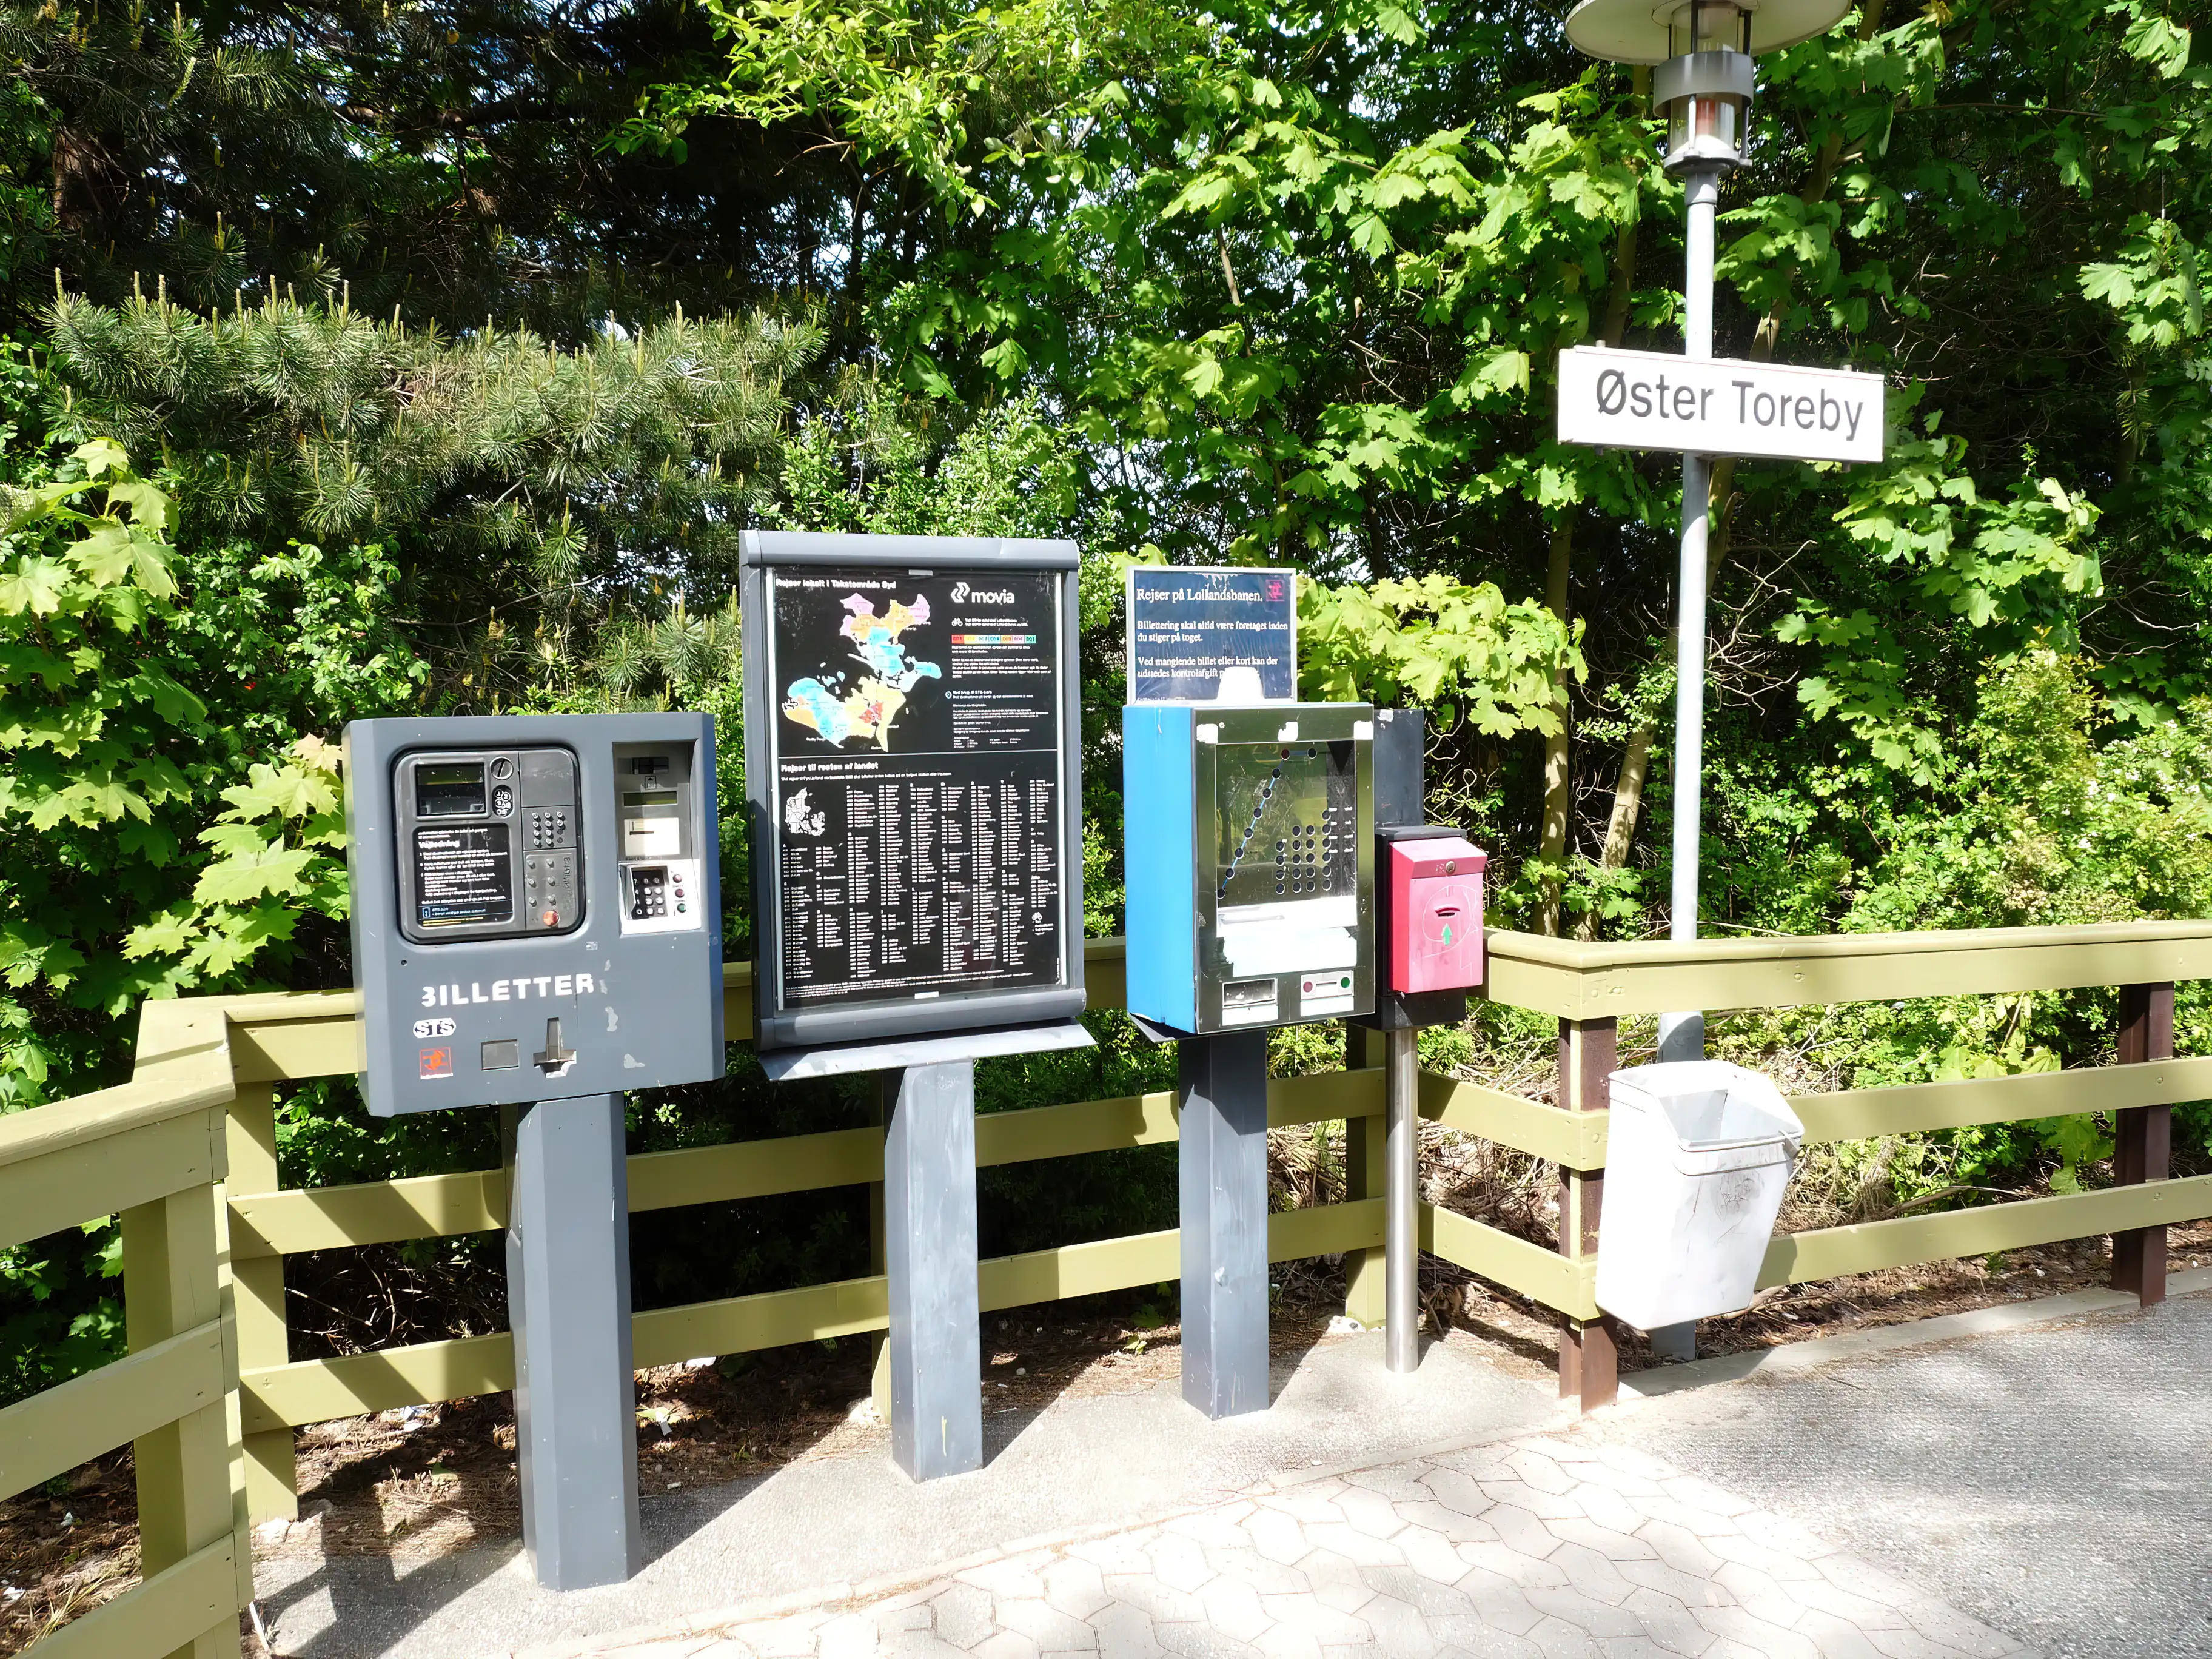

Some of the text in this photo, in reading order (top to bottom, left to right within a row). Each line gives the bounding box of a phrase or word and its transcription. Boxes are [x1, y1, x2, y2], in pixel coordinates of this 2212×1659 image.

[1596, 369, 1863, 441] Øster Toreby
[776, 578, 801, 588] Rejser
[882, 580, 897, 589] Syd
[971, 589, 1015, 604] movia
[1136, 588, 1263, 603] Rejser på Lollandsbanen.
[1137, 620, 1179, 632] Billettering
[1181, 621, 1196, 629] skal
[1198, 621, 1215, 629] altid
[1236, 621, 1267, 632] foretaget
[1269, 621, 1288, 630] inden
[1137, 632, 1204, 644] du stiger på toget.
[1138, 656, 1279, 668] Ved manglende billet eller kort kan der
[1138, 668, 1170, 677] udstedes
[1171, 668, 1218, 679] kontrolafgift
[781, 764, 806, 773] Rejser
[854, 762, 879, 770] landet
[416, 1019, 454, 1037] STS
